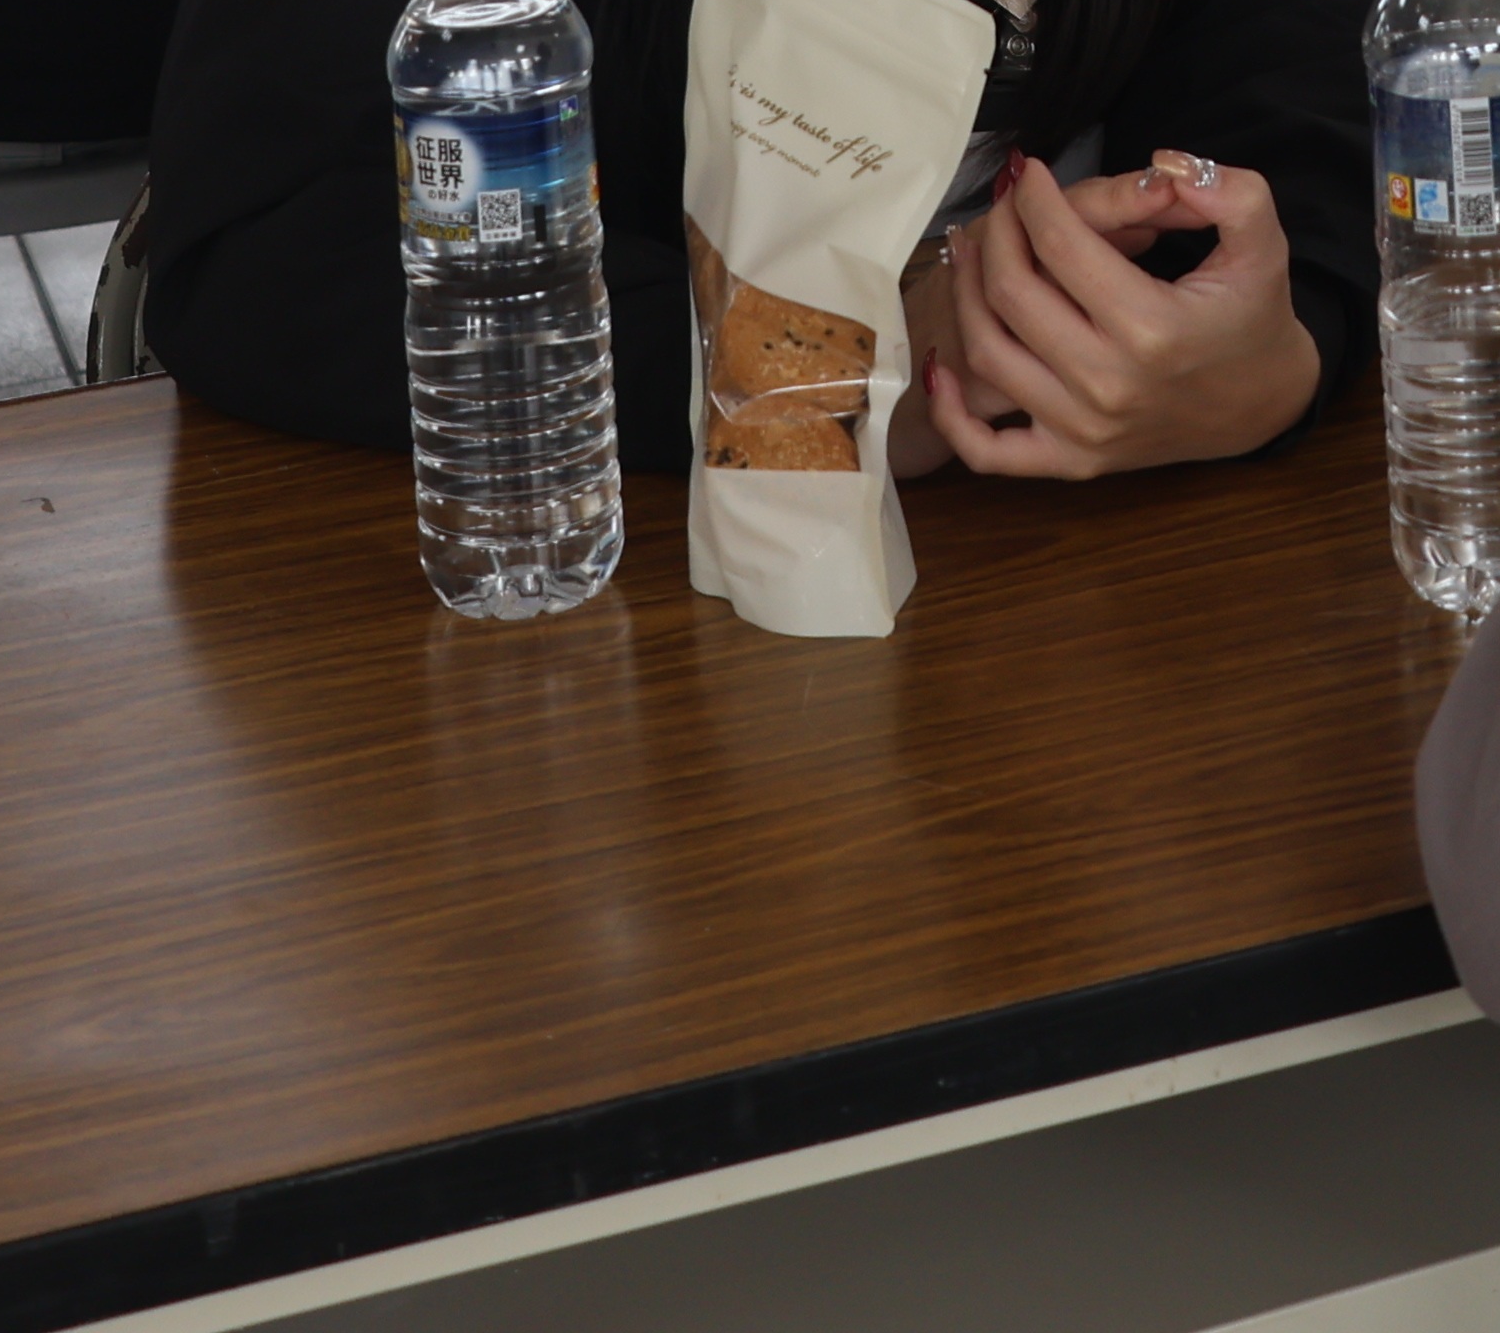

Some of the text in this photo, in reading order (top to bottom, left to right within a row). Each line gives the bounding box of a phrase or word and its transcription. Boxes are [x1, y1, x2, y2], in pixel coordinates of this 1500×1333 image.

[740, 82, 894, 180] is my taste of life
[416, 136, 463, 163] 征服
[417, 162, 464, 189] 世界
